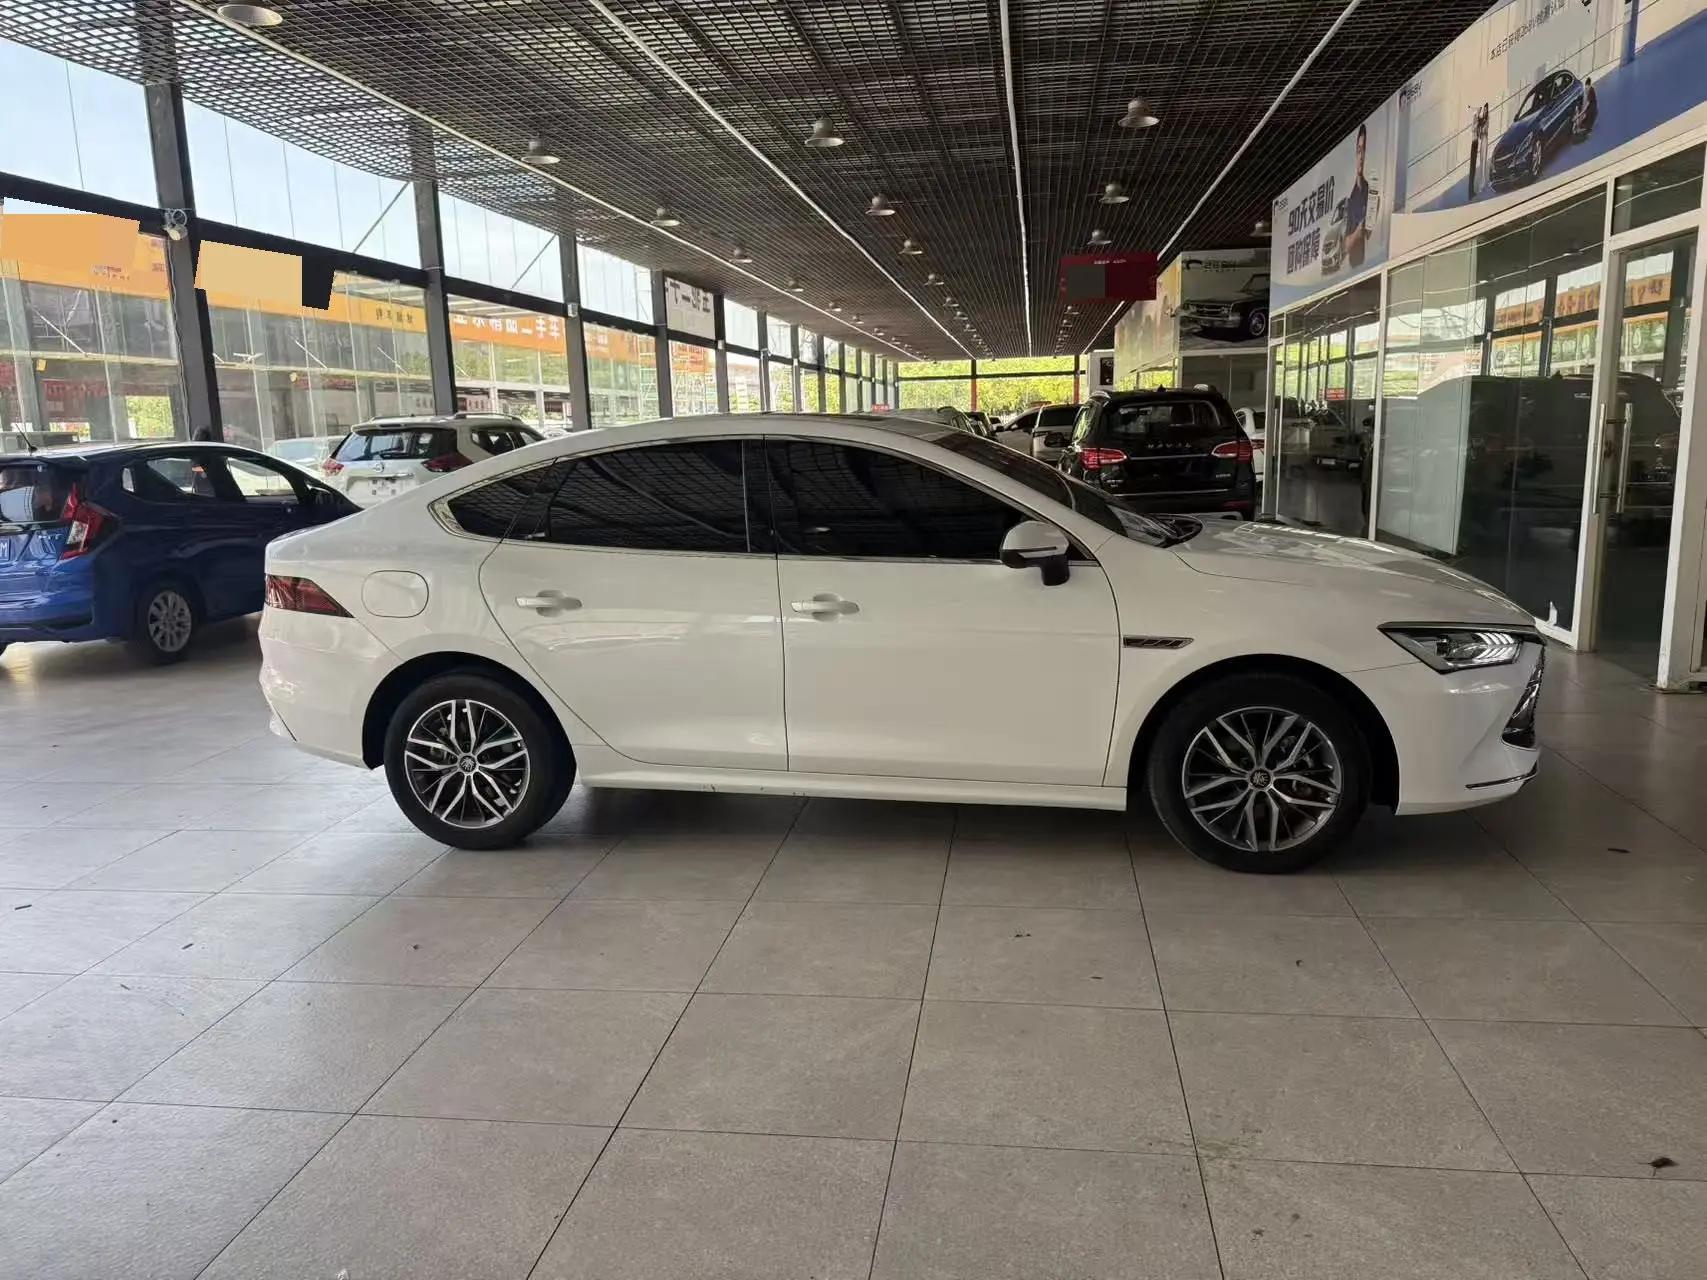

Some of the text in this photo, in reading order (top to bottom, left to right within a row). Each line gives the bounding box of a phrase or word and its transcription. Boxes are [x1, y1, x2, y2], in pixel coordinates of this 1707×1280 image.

[1288, 175, 1335, 237] 90天交易价
[1287, 227, 1321, 274] 回购保障
